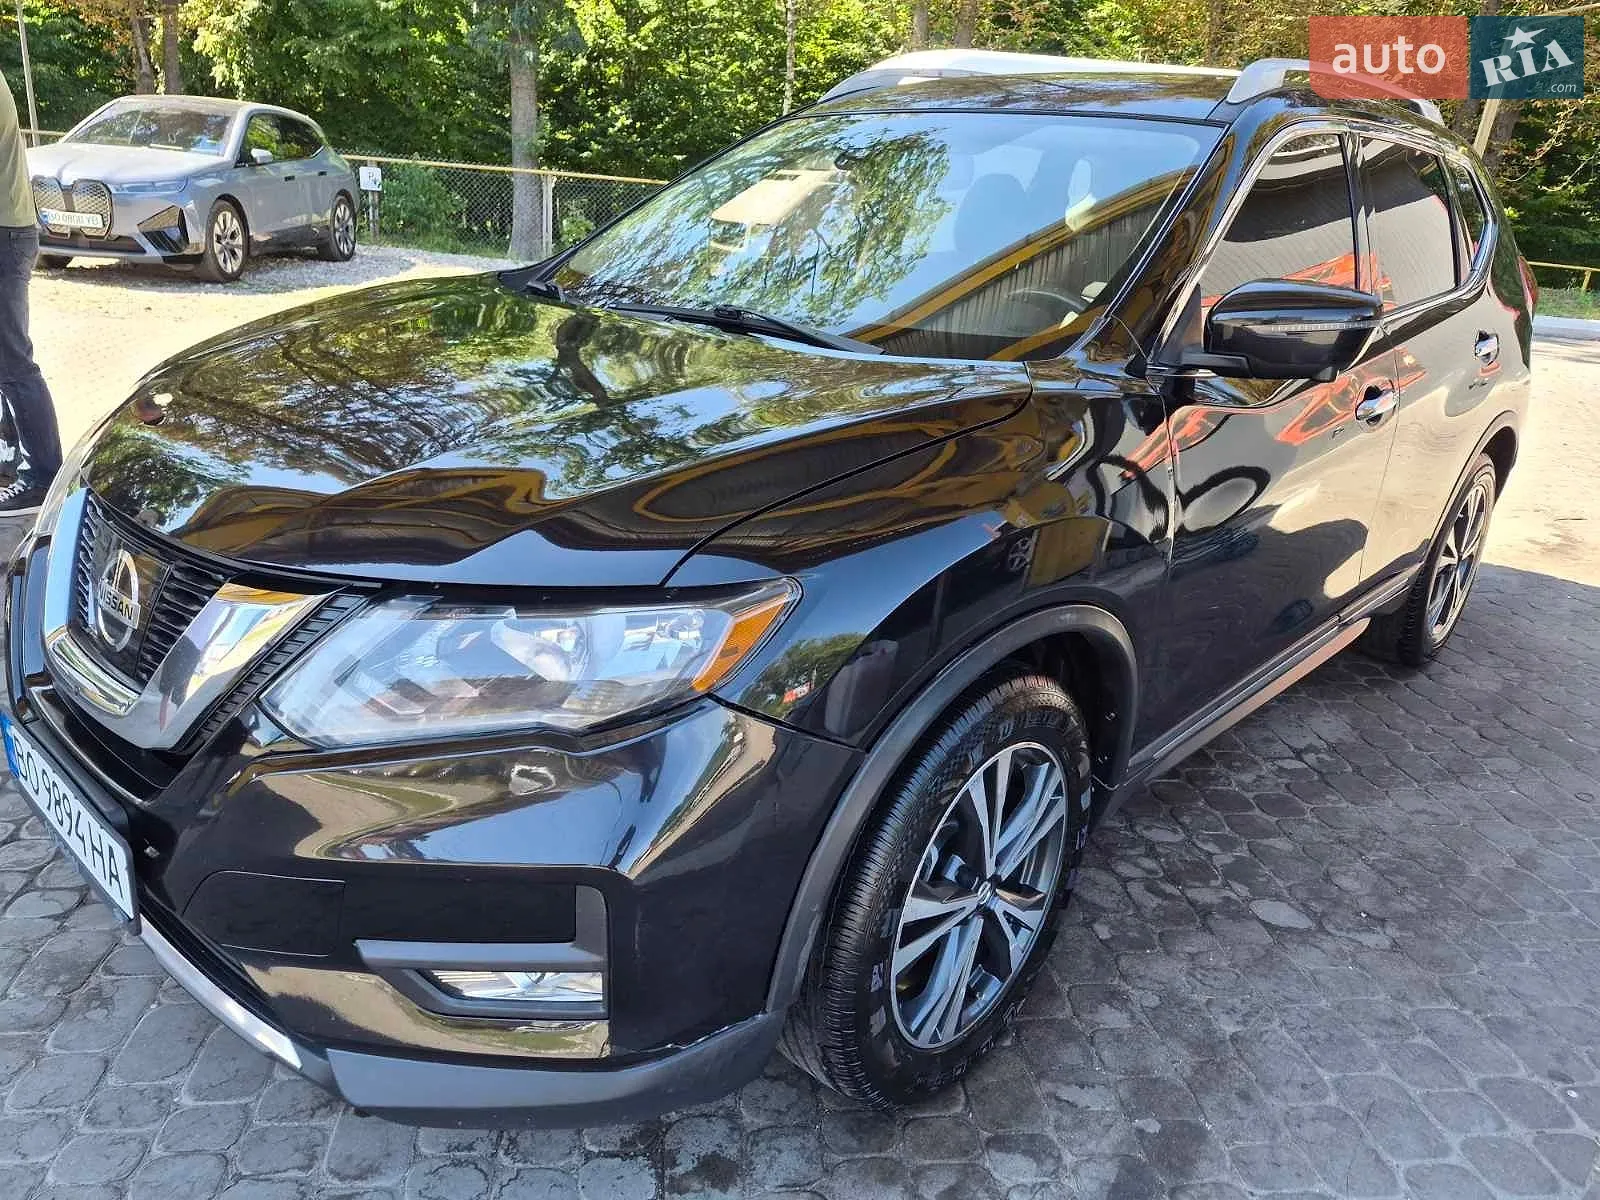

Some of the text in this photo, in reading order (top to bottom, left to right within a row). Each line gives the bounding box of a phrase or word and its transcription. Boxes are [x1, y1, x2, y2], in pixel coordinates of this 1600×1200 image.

[99, 580, 133, 620] NISSAN
[13, 735, 124, 899] BO 9894 HA
